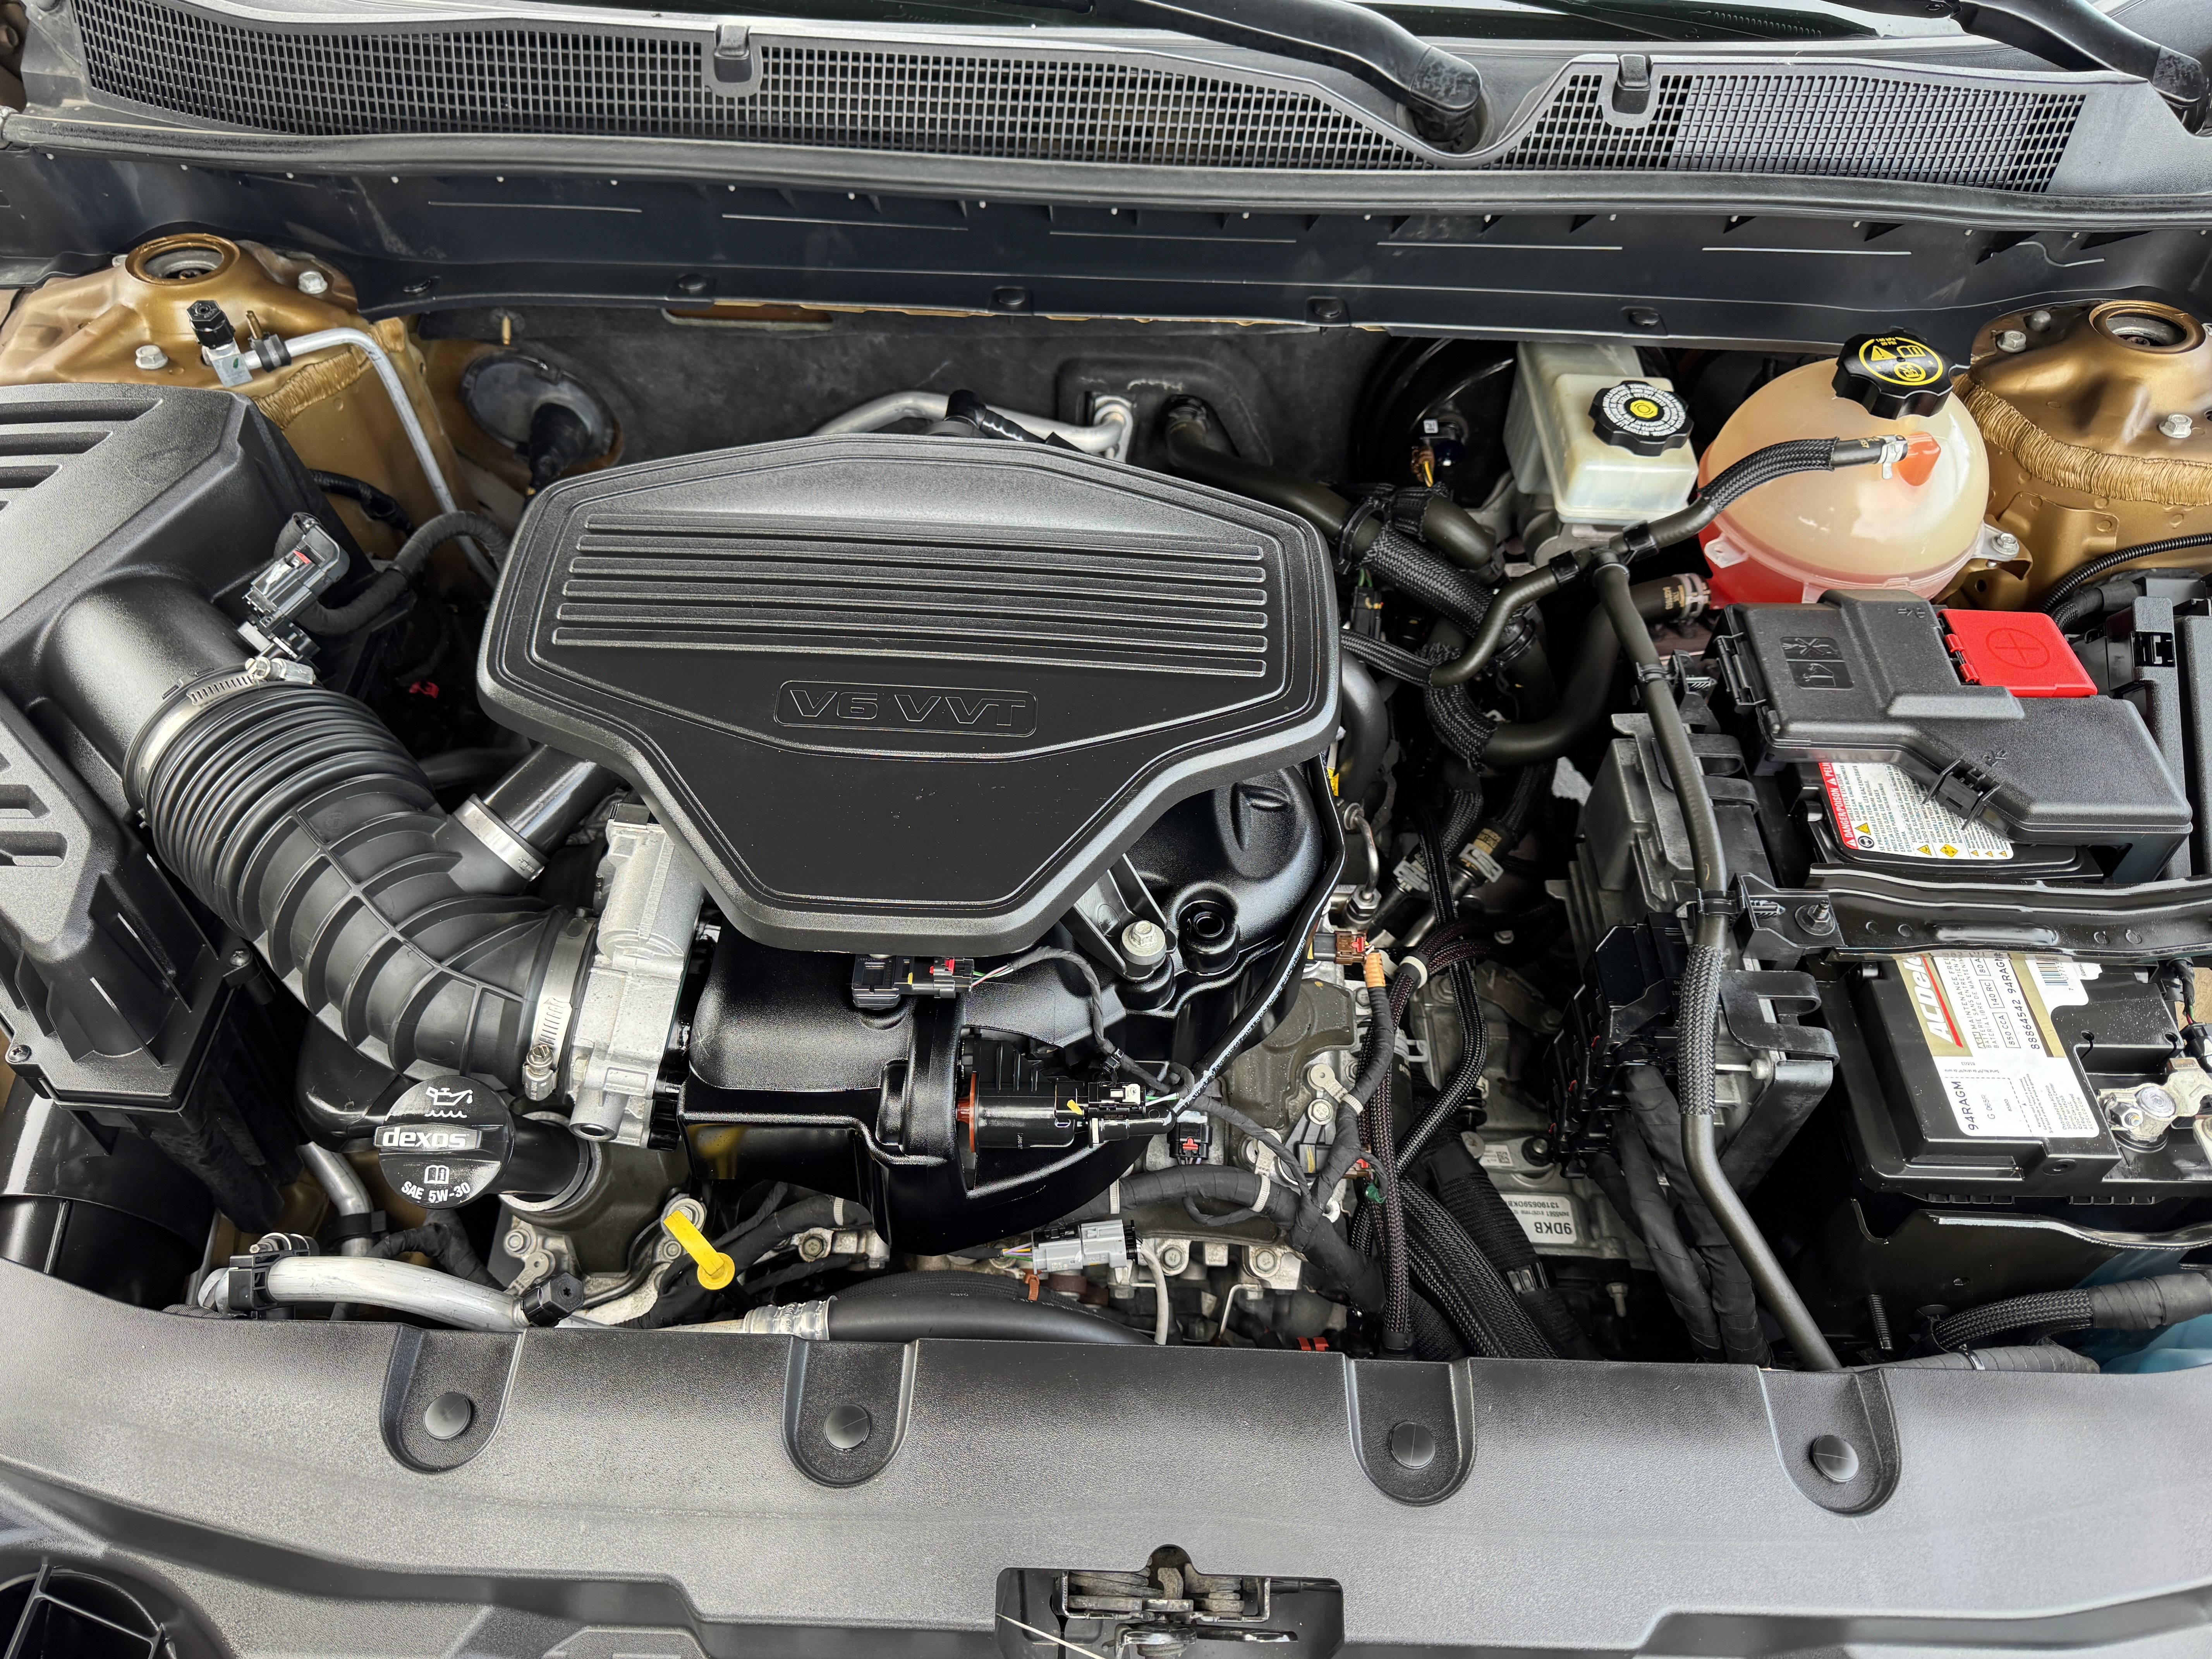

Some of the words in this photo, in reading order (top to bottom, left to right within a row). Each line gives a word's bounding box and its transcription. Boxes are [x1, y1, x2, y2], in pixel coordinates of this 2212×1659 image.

[790, 689, 878, 720] V6
[895, 694, 1026, 726] VVT
[1822, 763, 1834, 777] PELI
[1830, 788, 1853, 838] DANGER/POISON
[1906, 823, 1917, 843] SULFURIC
[1943, 957, 1954, 974] FREE
[1977, 965, 1985, 973] 80
[1953, 964, 1971, 997] ENTRETIEN
[1985, 982, 1993, 991] RC
[1951, 977, 1977, 1029] MAINTENANCE
[1968, 1000, 1978, 1015] SANS
[1989, 994, 1999, 1005] 140
[1976, 1002, 1987, 1019] LIBRE
[1998, 1015, 2008, 1029] CCA
[2012, 1000, 2040, 1049] 88864542
[1975, 1019, 1992, 1048] BATTERIE
[2005, 1032, 2015, 1045] 850
[1951, 1082, 1978, 1130] 94RAGM
[401, 1181, 424, 1200] SAE
[428, 1182, 471, 1203] 5W-30
[1534, 1222, 1573, 1235] 9DKB
